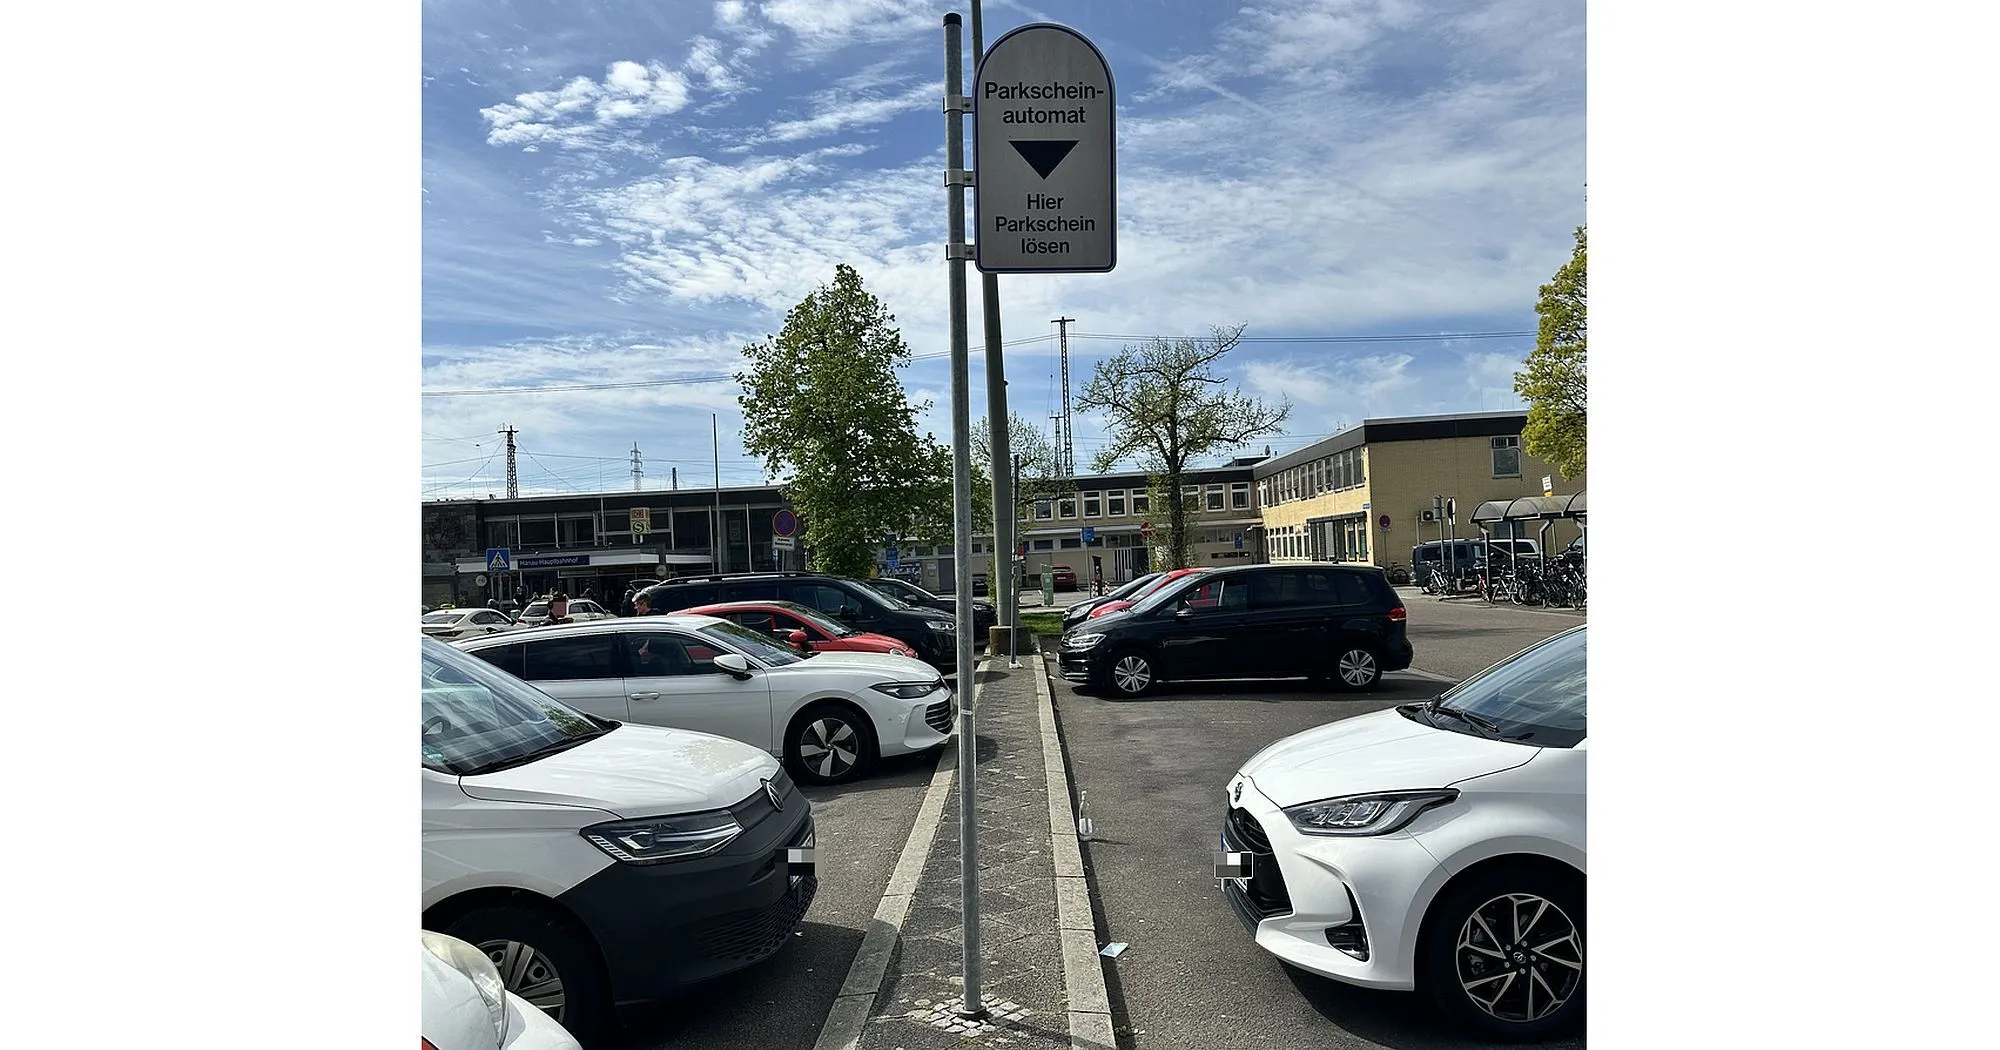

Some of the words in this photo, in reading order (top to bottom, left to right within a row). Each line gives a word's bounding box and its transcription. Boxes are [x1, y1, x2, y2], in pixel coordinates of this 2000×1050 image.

[985, 82, 1104, 99] Parkschein-
[1003, 107, 1086, 124] automat
[1027, 194, 1064, 210] Hier
[995, 216, 1095, 232] Parkschein
[1021, 238, 1070, 254] lösen
[539, 557, 579, 566] Hauptbahnhof
